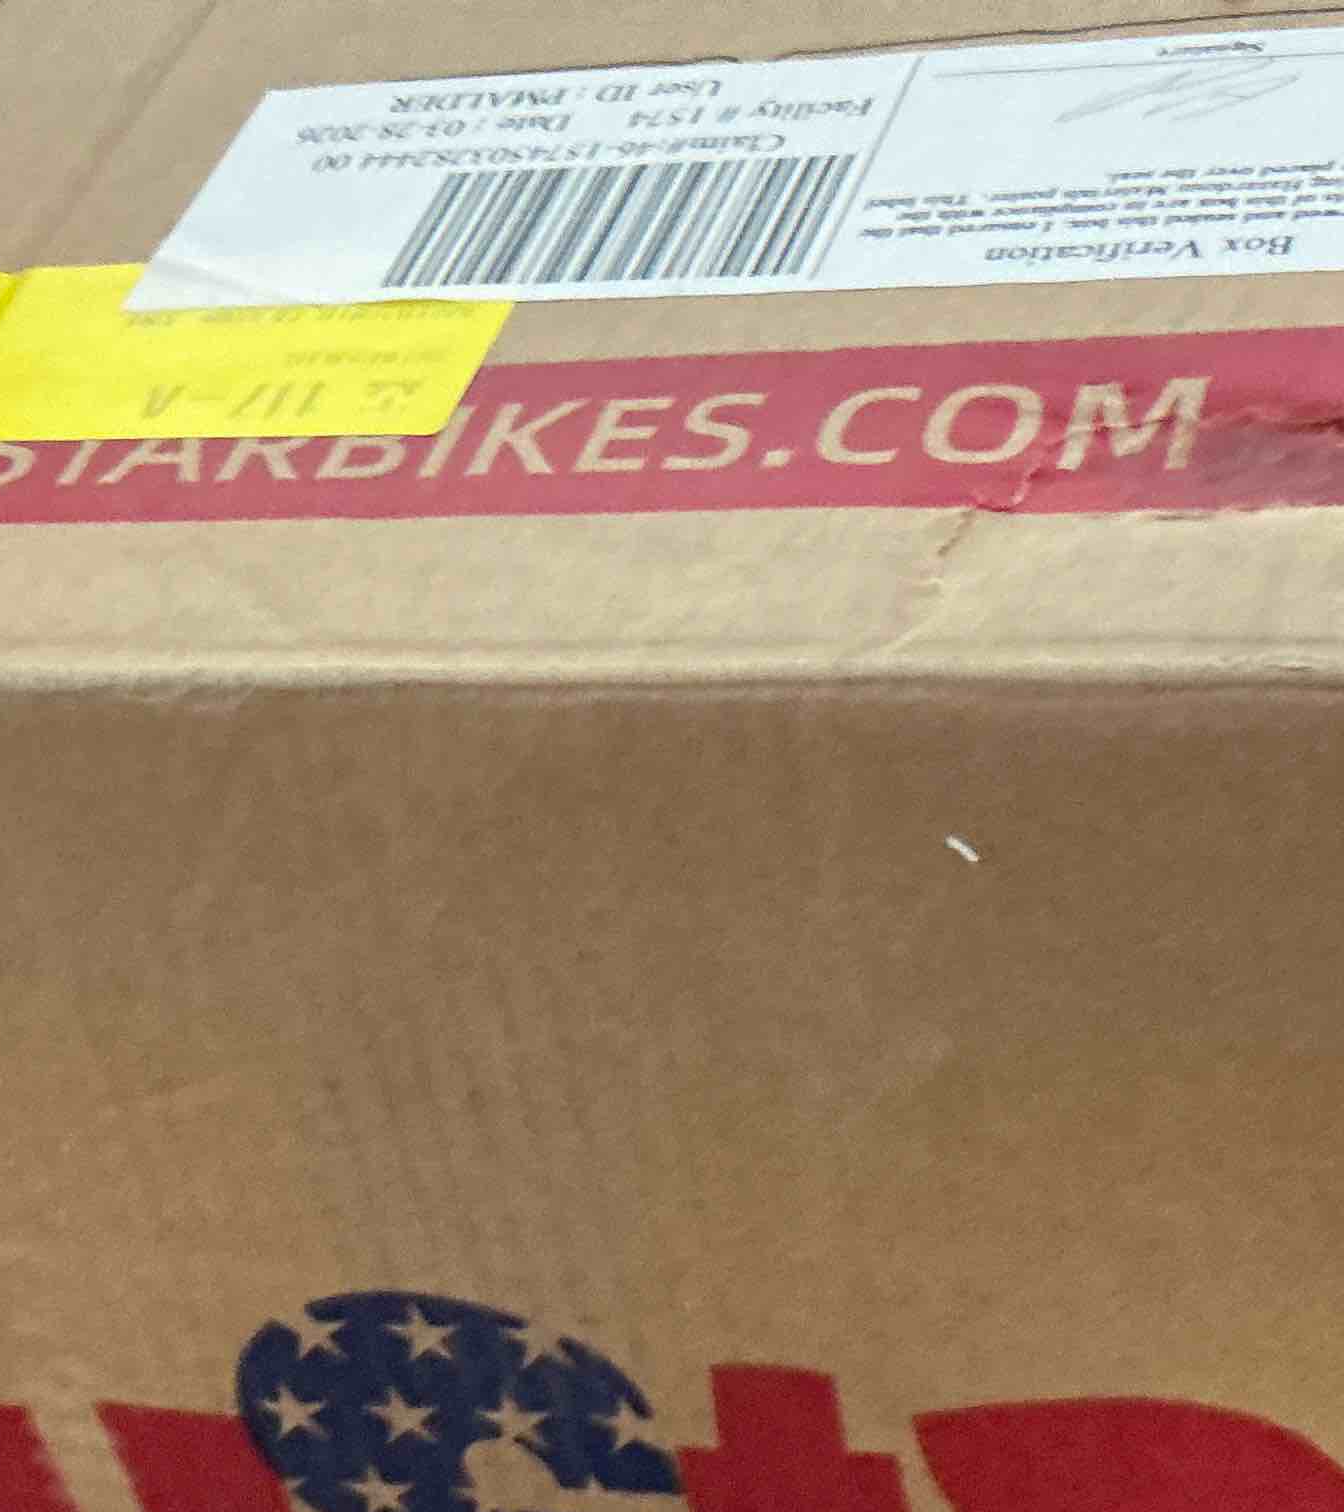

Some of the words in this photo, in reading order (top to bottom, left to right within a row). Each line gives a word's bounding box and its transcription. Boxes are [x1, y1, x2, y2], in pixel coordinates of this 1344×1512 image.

[591, 82, 641, 103] ID
[645, 78, 725, 100] User
[621, 107, 707, 128] 1574
[712, 105, 742, 124] #
[745, 94, 877, 123] Facility
[487, 112, 574, 135] Date
[983, 240, 1203, 264] Verification
[1220, 237, 1294, 257] Box
